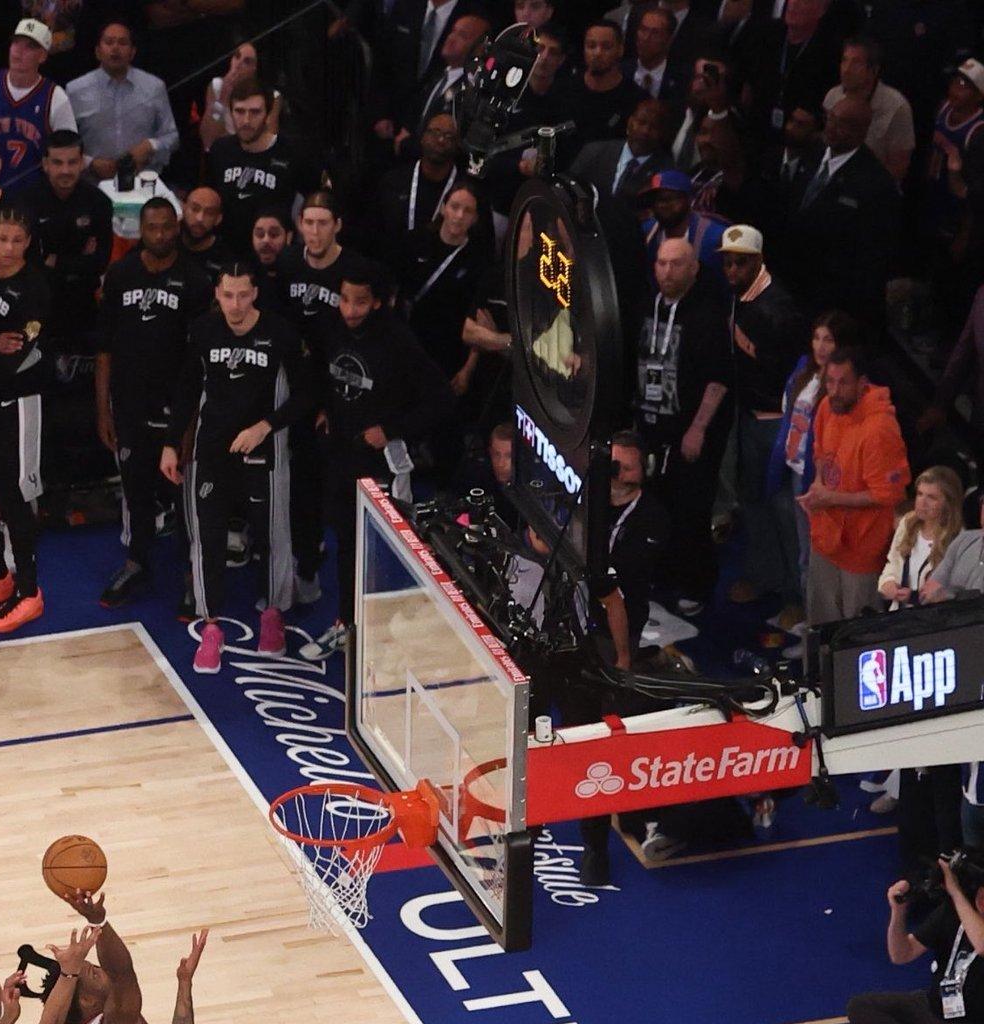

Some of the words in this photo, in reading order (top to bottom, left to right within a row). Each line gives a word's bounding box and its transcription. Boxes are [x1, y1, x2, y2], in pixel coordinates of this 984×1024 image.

[7, 140, 27, 167] 7
[224, 166, 277, 190] SPURS
[122, 288, 179, 311] SPURS
[209, 348, 269, 370] SPURS
[890, 646, 956, 710] App
